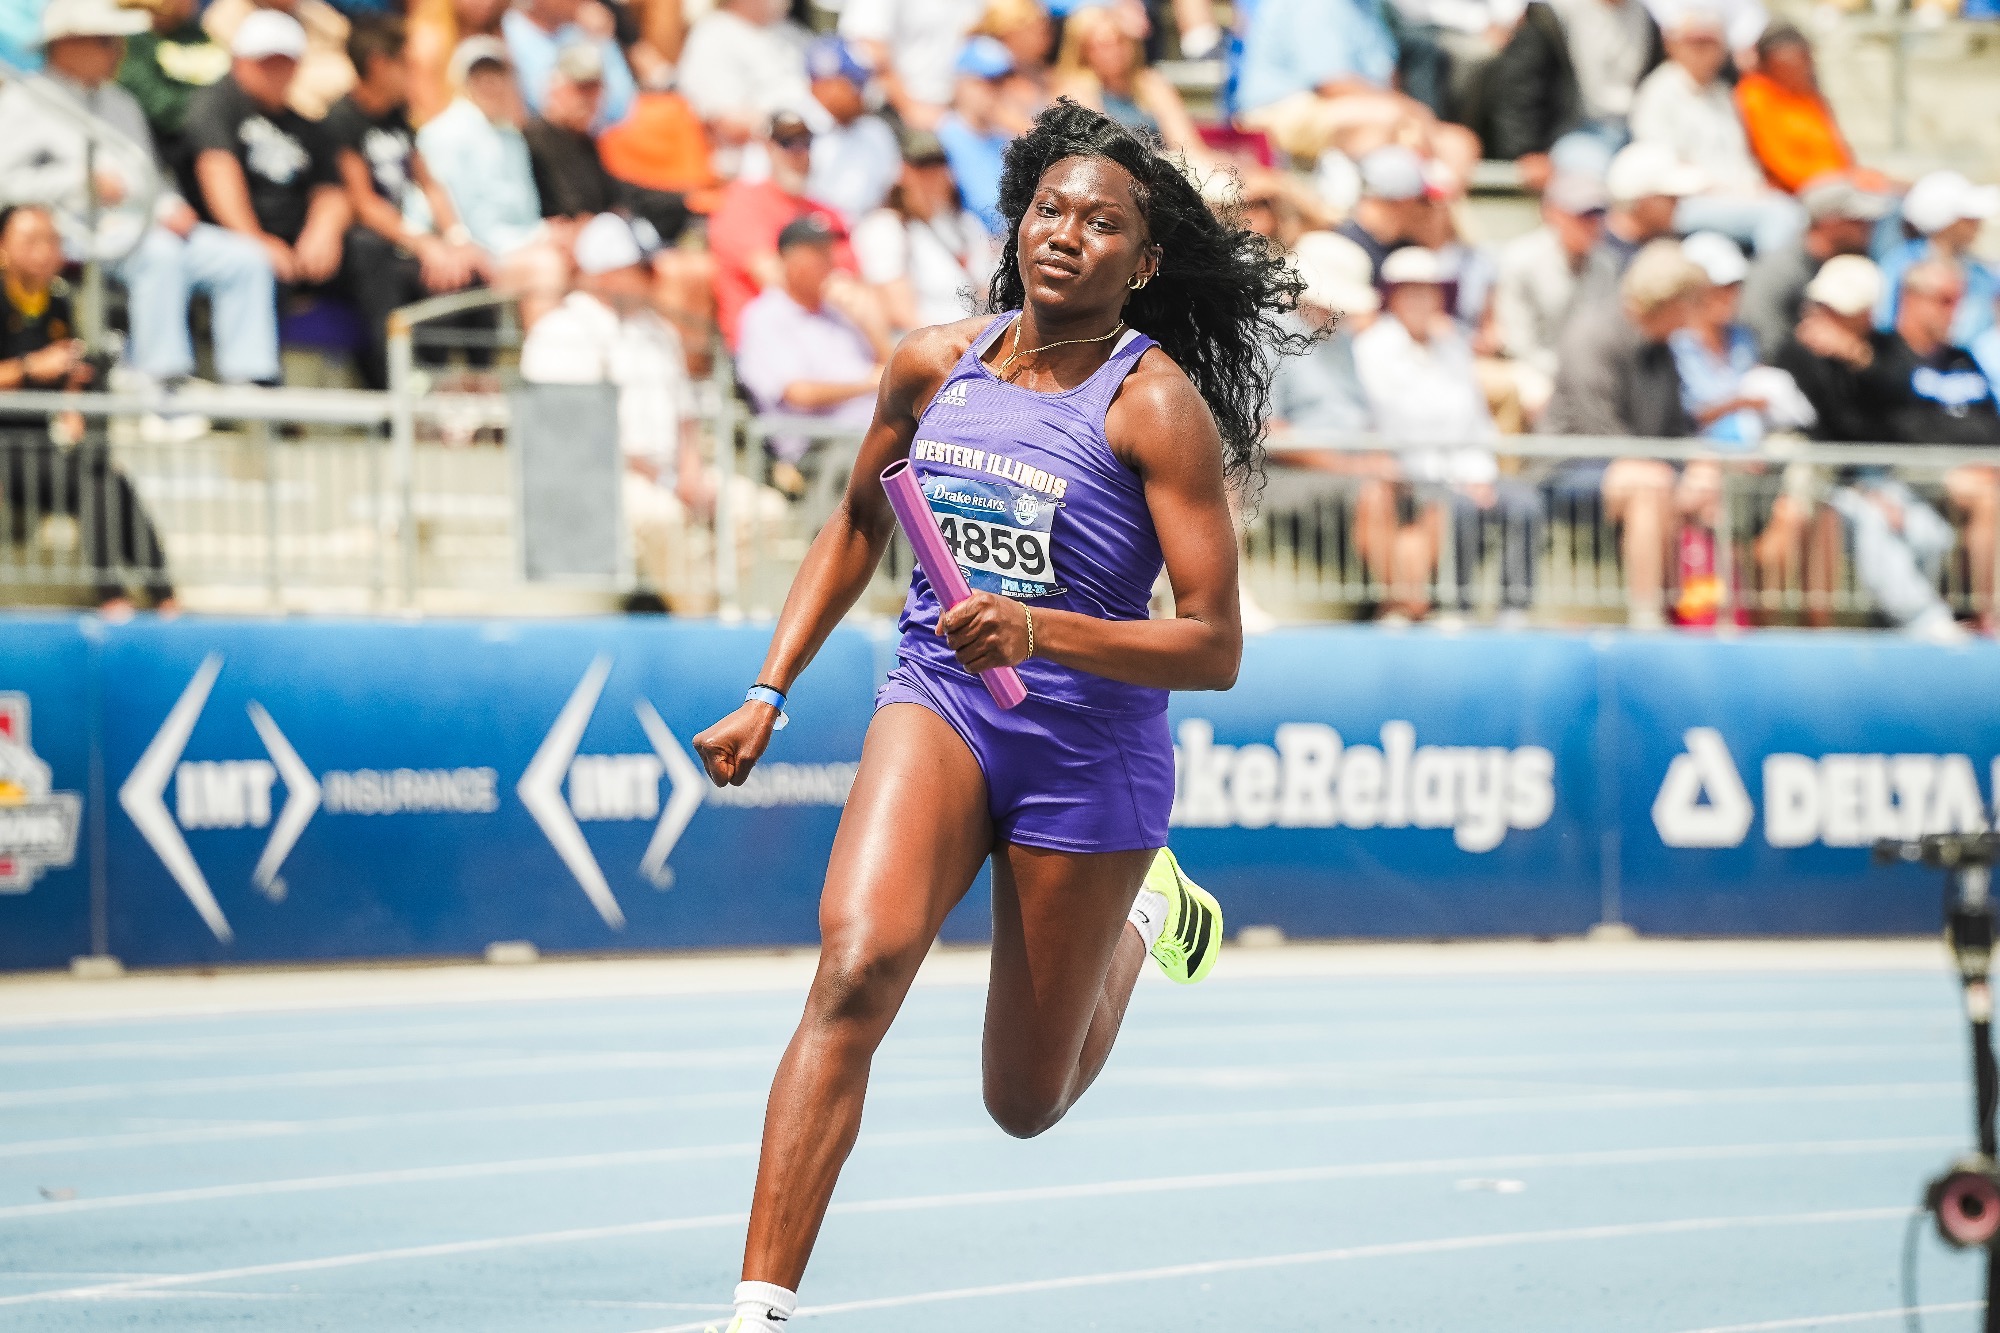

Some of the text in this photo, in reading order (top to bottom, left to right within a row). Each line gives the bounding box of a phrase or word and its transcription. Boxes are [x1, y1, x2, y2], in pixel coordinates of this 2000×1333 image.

[915, 439, 1068, 498] WESTERN ILLINOIS
[933, 484, 972, 504] Drake
[939, 517, 1046, 576] 4859
[176, 759, 499, 830] IMT INSURANCE
[567, 753, 666, 821] IMT
[1172, 718, 1555, 853] keRelays
[1762, 752, 1988, 848] DELTA
